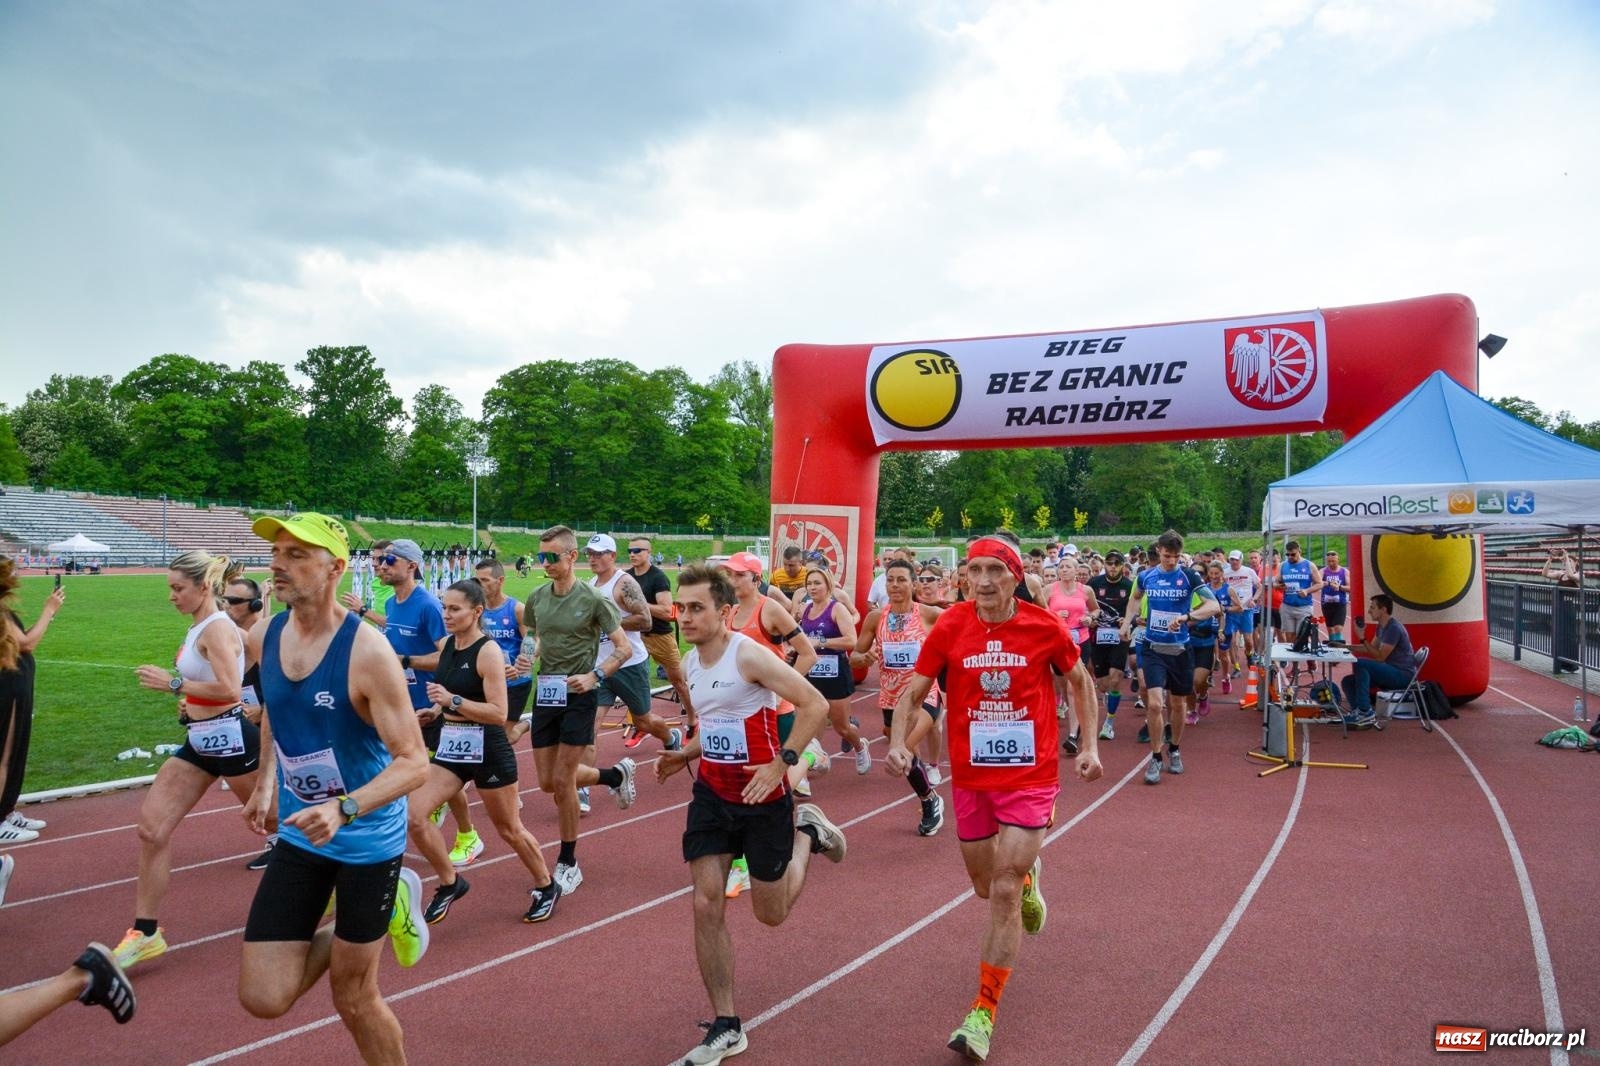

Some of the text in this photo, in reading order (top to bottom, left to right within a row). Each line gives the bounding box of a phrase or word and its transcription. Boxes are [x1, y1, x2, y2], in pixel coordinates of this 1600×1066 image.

[1044, 337, 1127, 357] BIEG
[915, 358, 960, 375] SIR
[986, 361, 1187, 395] BEZ GRANIC
[1005, 395, 1171, 427] RACIBÓRZ
[986, 640, 1003, 652] OD
[893, 652, 910, 662] 151
[963, 651, 1028, 668] URODZENIA
[815, 663, 831, 672] 236
[543, 687, 557, 698] 237
[972, 705, 1028, 721] POCHODZENIA
[979, 700, 1014, 711] DUMNI
[202, 734, 229, 749] 223
[448, 740, 472, 753] 242
[706, 735, 730, 750] 190
[986, 739, 1018, 754] 168
